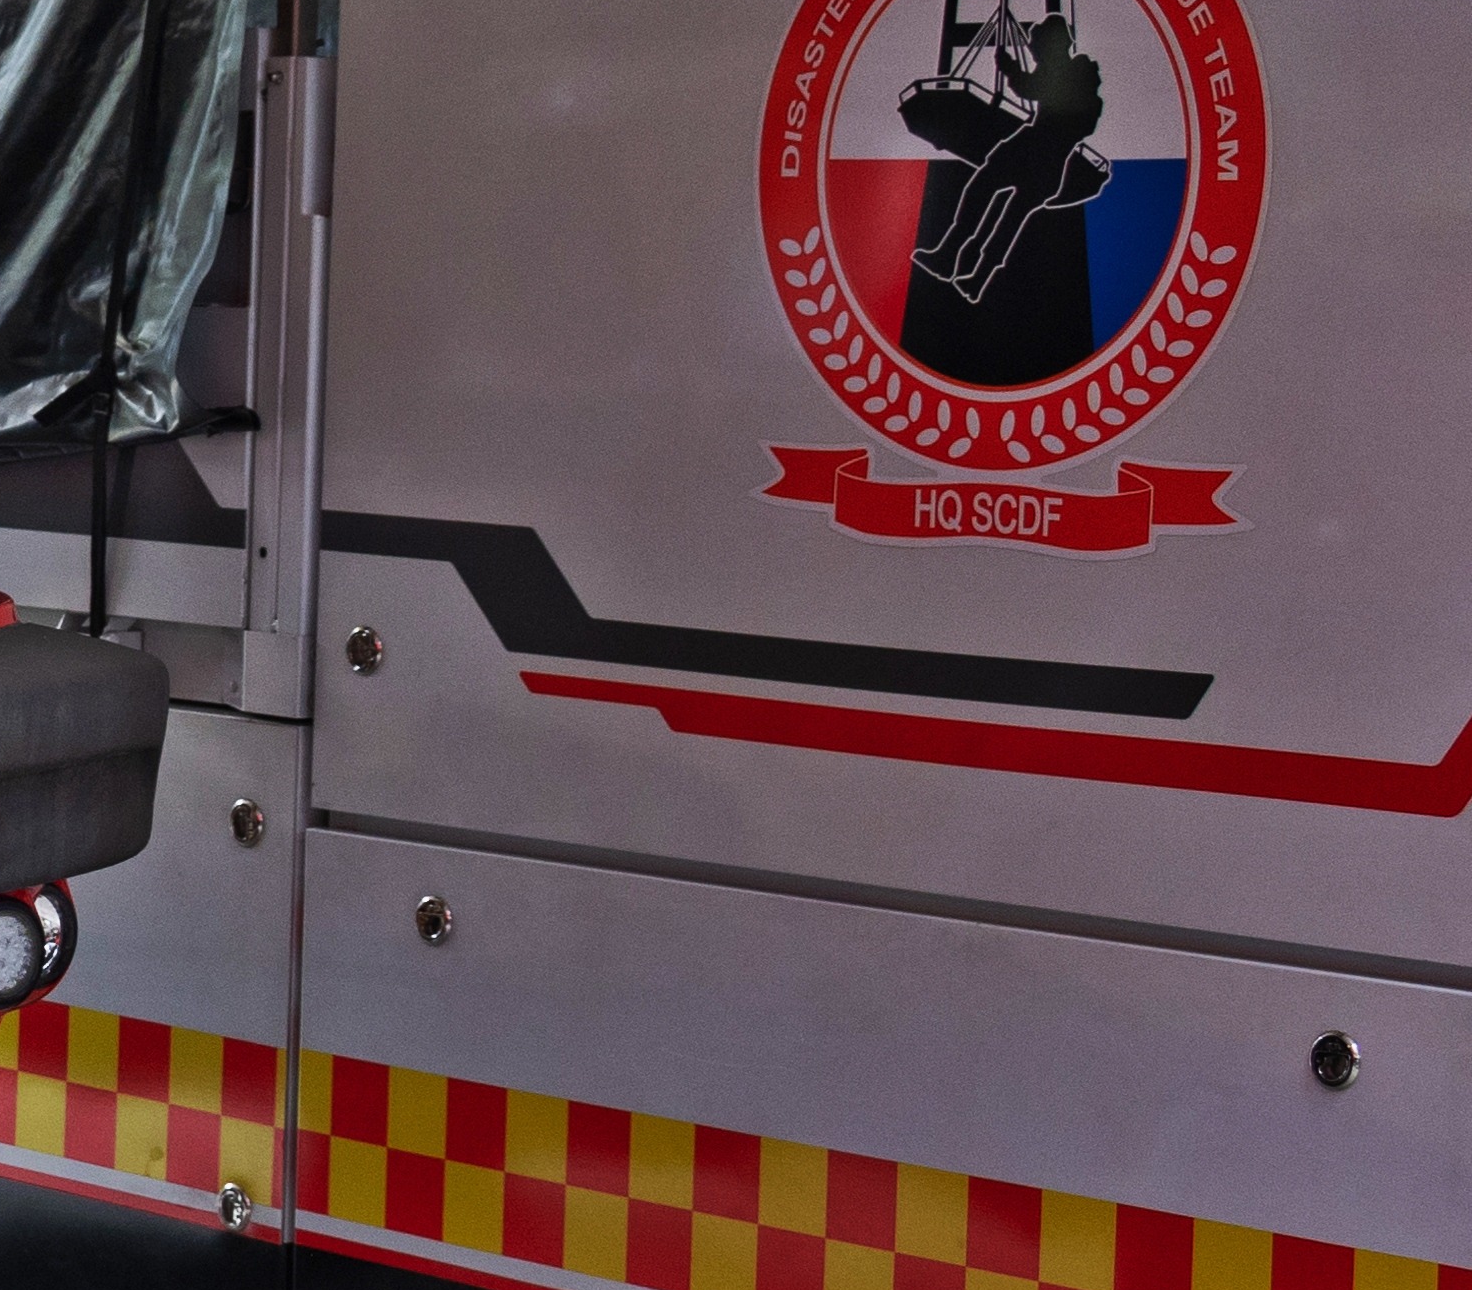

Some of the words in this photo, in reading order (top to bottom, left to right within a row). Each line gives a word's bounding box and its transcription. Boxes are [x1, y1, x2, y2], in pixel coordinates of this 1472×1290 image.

[1203, 38, 1239, 182] TEAM
[914, 488, 962, 533] HQ
[972, 492, 1065, 538] SCDF
